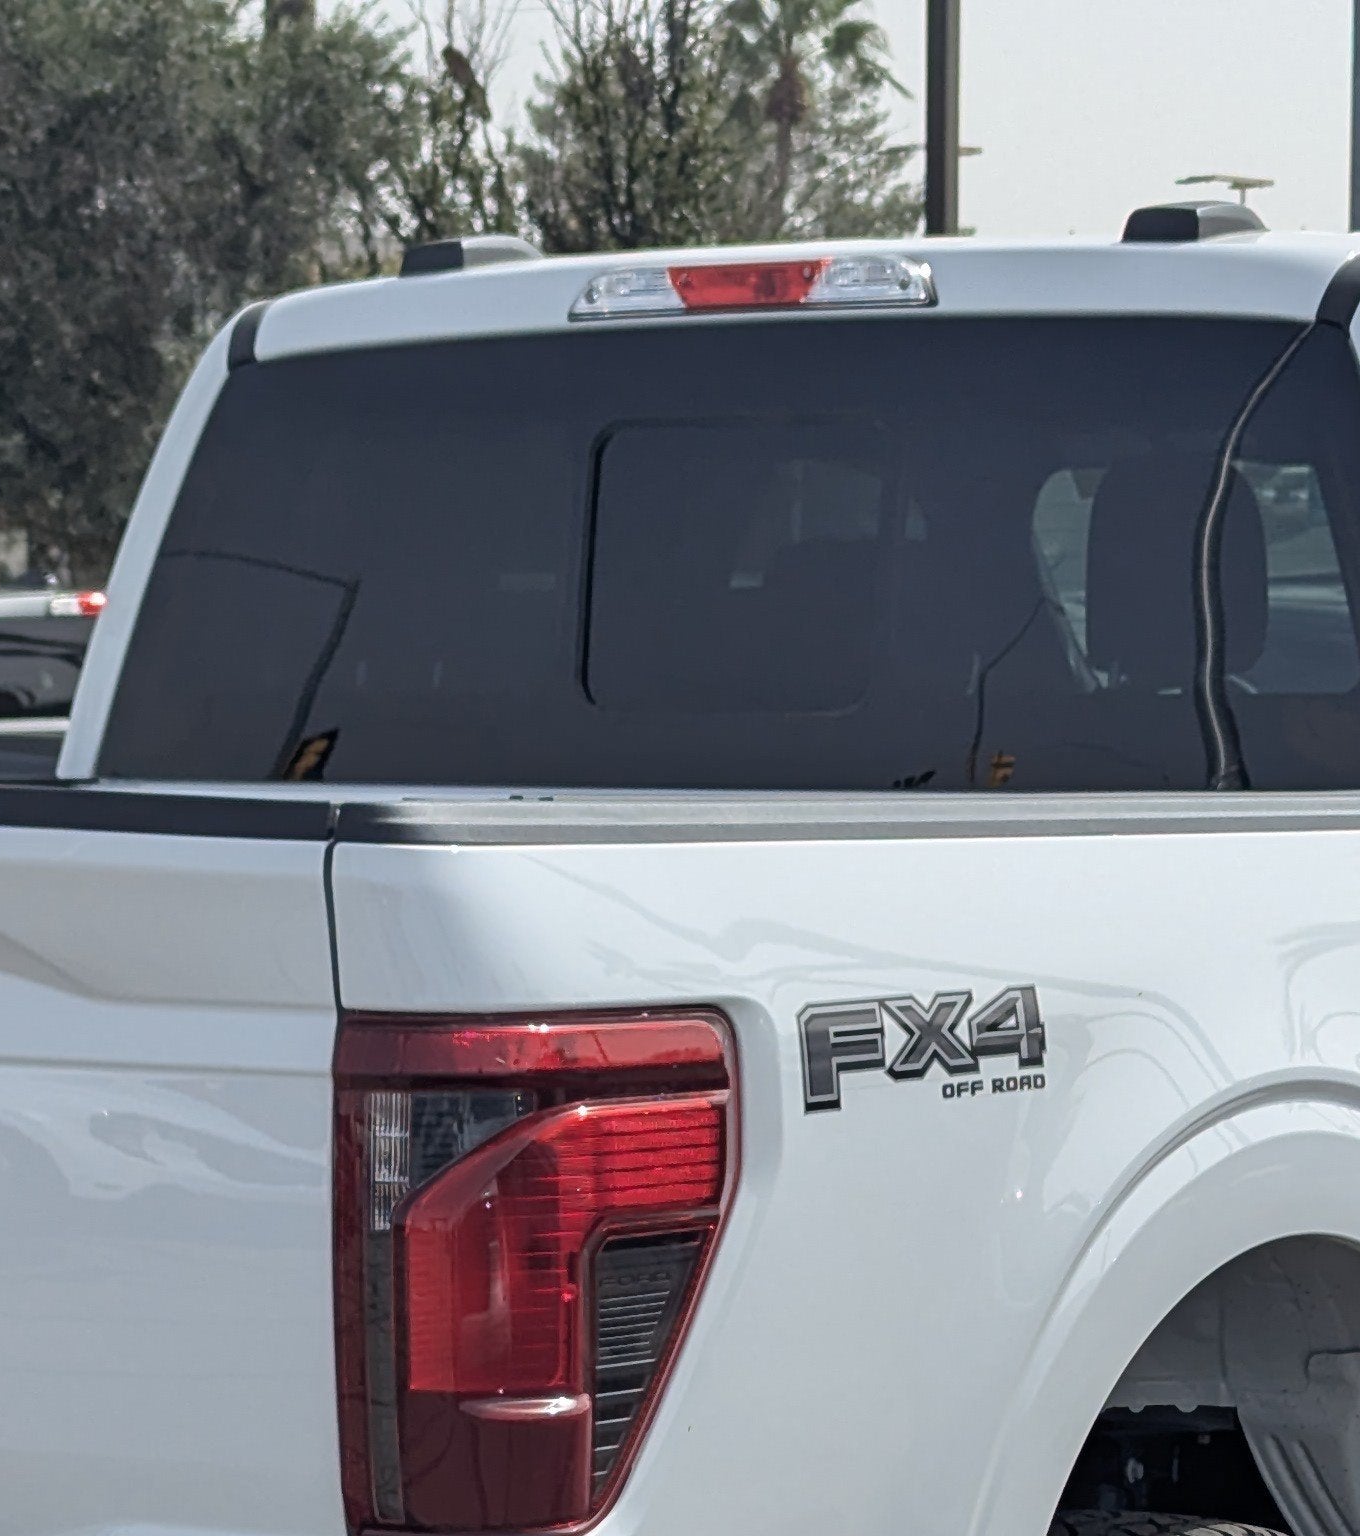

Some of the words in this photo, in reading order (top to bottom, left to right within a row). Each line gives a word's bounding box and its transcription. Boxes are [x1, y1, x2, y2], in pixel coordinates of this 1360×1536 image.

[796, 983, 1048, 1116] FX4
[941, 1078, 984, 1100] OFF
[991, 1073, 1046, 1095] ROAD
